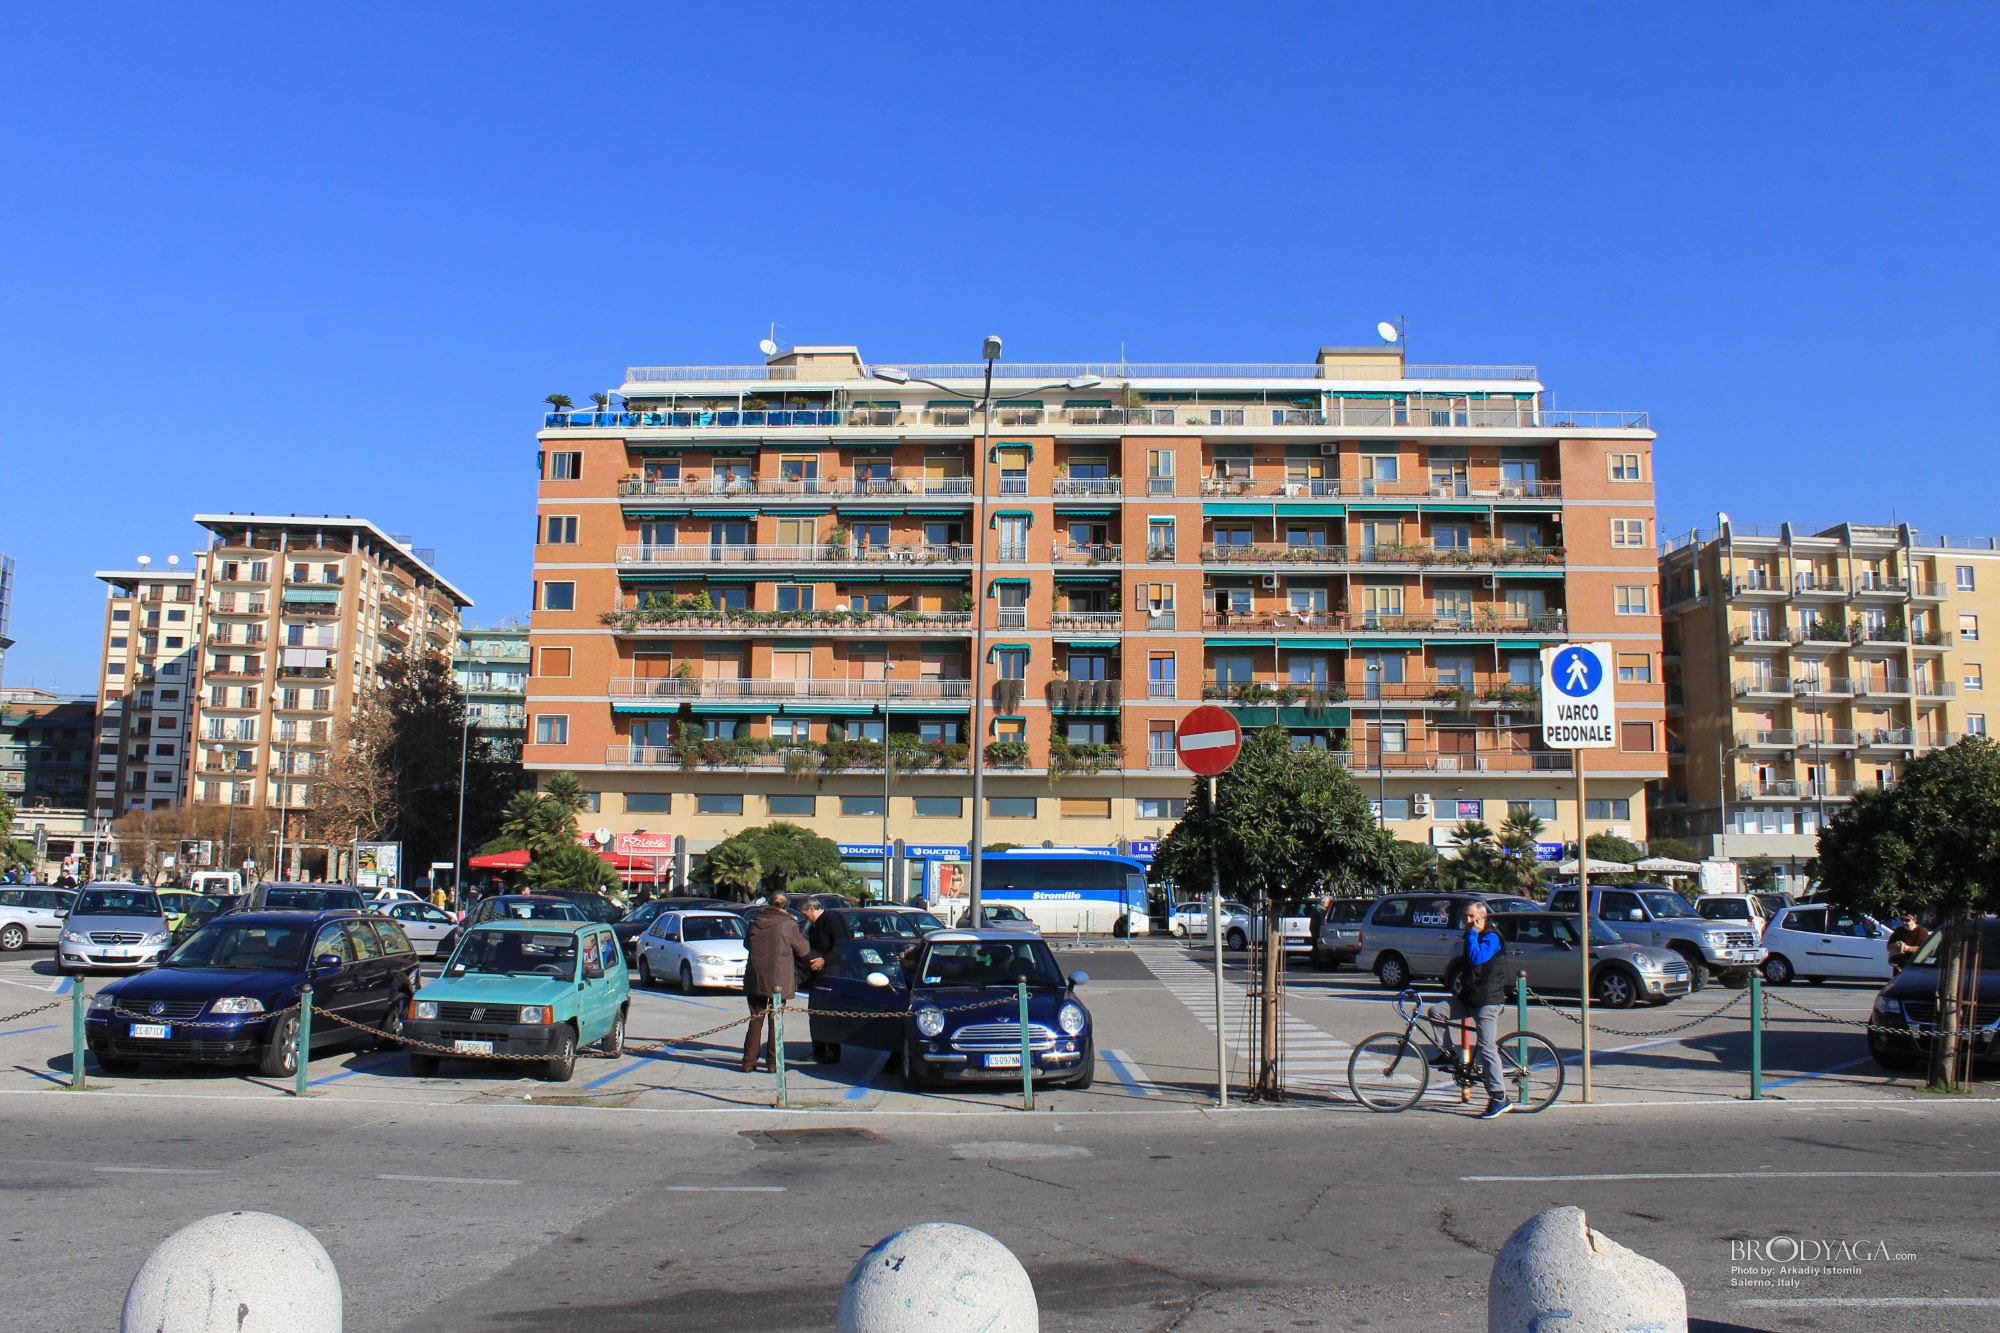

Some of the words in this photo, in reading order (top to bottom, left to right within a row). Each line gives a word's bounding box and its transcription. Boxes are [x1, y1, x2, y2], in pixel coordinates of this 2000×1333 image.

[1557, 704, 1599, 721] VARCO
[1546, 725, 1612, 742] PEDONALE
[1138, 843, 1149, 852] La
[1032, 891, 1082, 900] Stromillo
